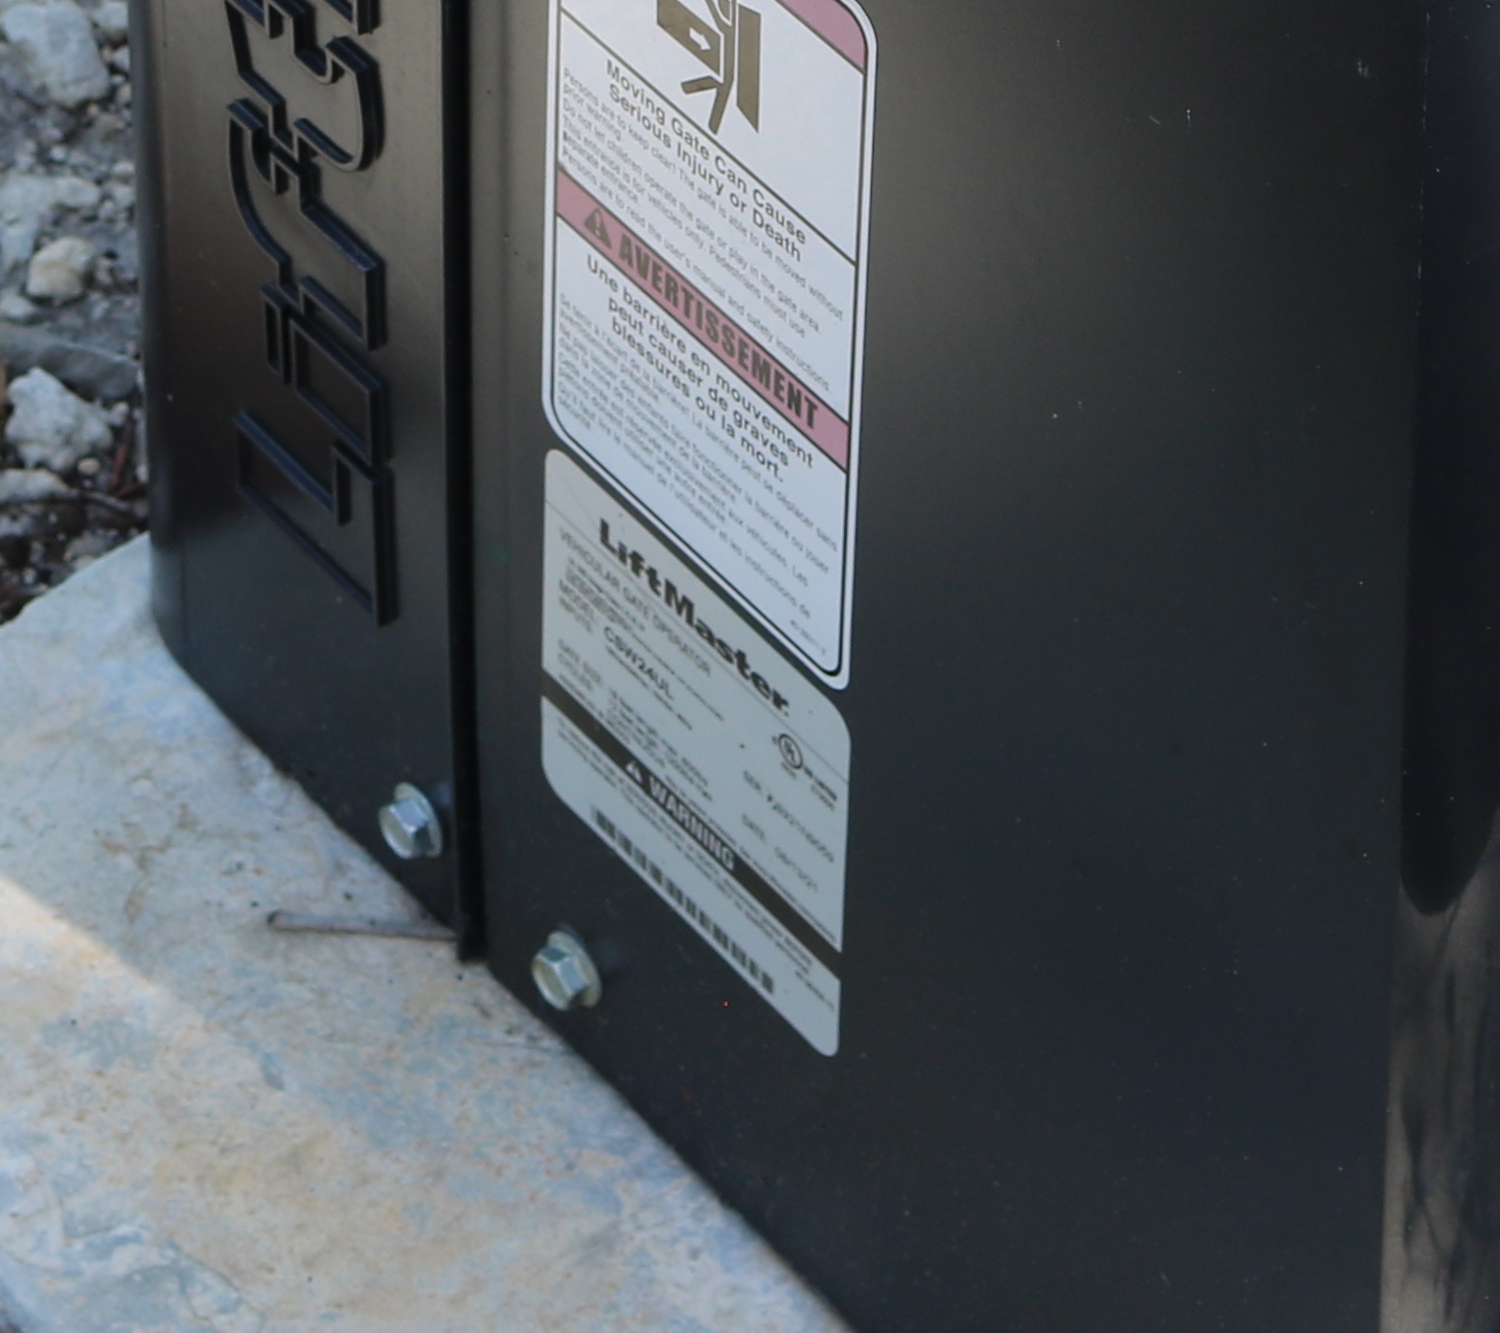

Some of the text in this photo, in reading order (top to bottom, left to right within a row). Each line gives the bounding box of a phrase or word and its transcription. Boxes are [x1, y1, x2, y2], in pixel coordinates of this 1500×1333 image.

[605, 57, 806, 247] Moving Gate Can Cause
[608, 80, 801, 264] Serious Injury or Death
[586, 252, 813, 470] Une barrière en mouvement
[608, 292, 789, 472] peut causer de graves
[611, 315, 784, 485] blessures ou la mort.
[618, 228, 818, 435] AVERTISSEMENT
[598, 514, 790, 721] LiftMaster
[649, 773, 735, 875] WARNING
